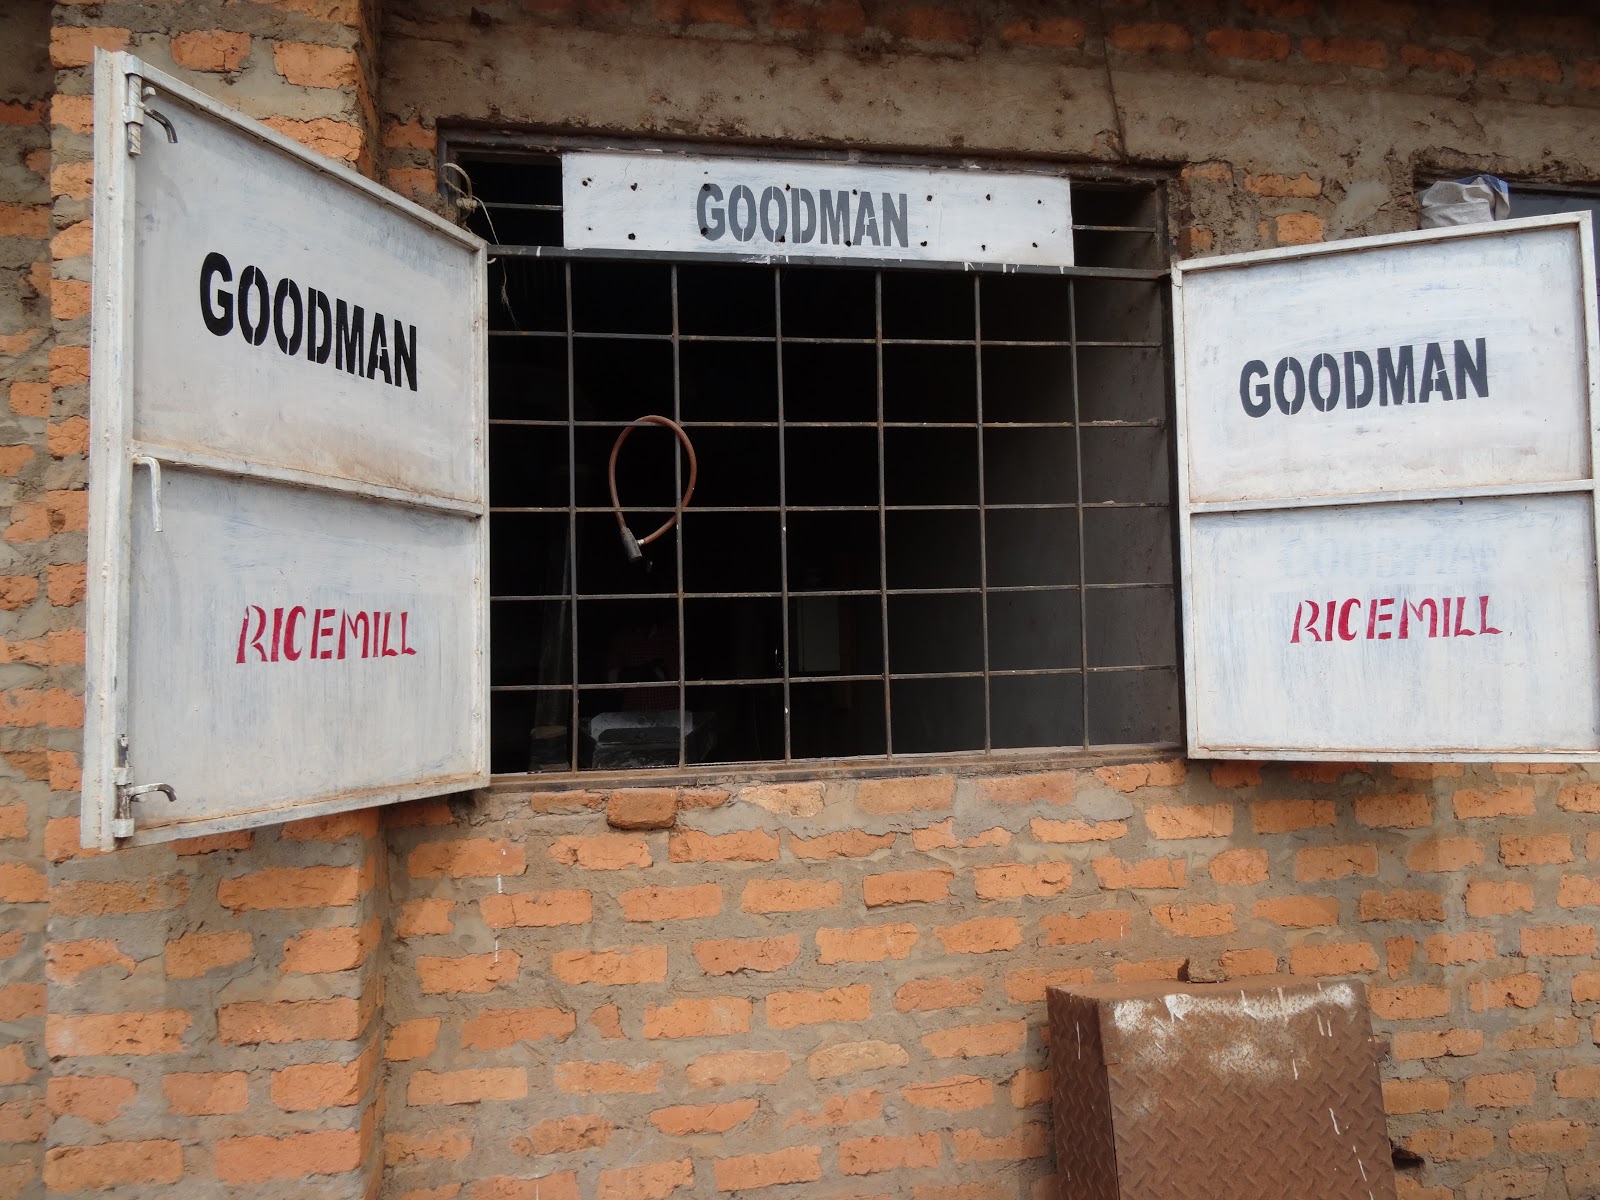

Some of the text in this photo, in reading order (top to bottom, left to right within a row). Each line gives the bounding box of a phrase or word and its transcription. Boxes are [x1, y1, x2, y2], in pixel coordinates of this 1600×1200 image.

[695, 183, 909, 248] GOODMAN
[200, 252, 418, 392] GOODMAN
[1239, 337, 1489, 418] GOODMAN
